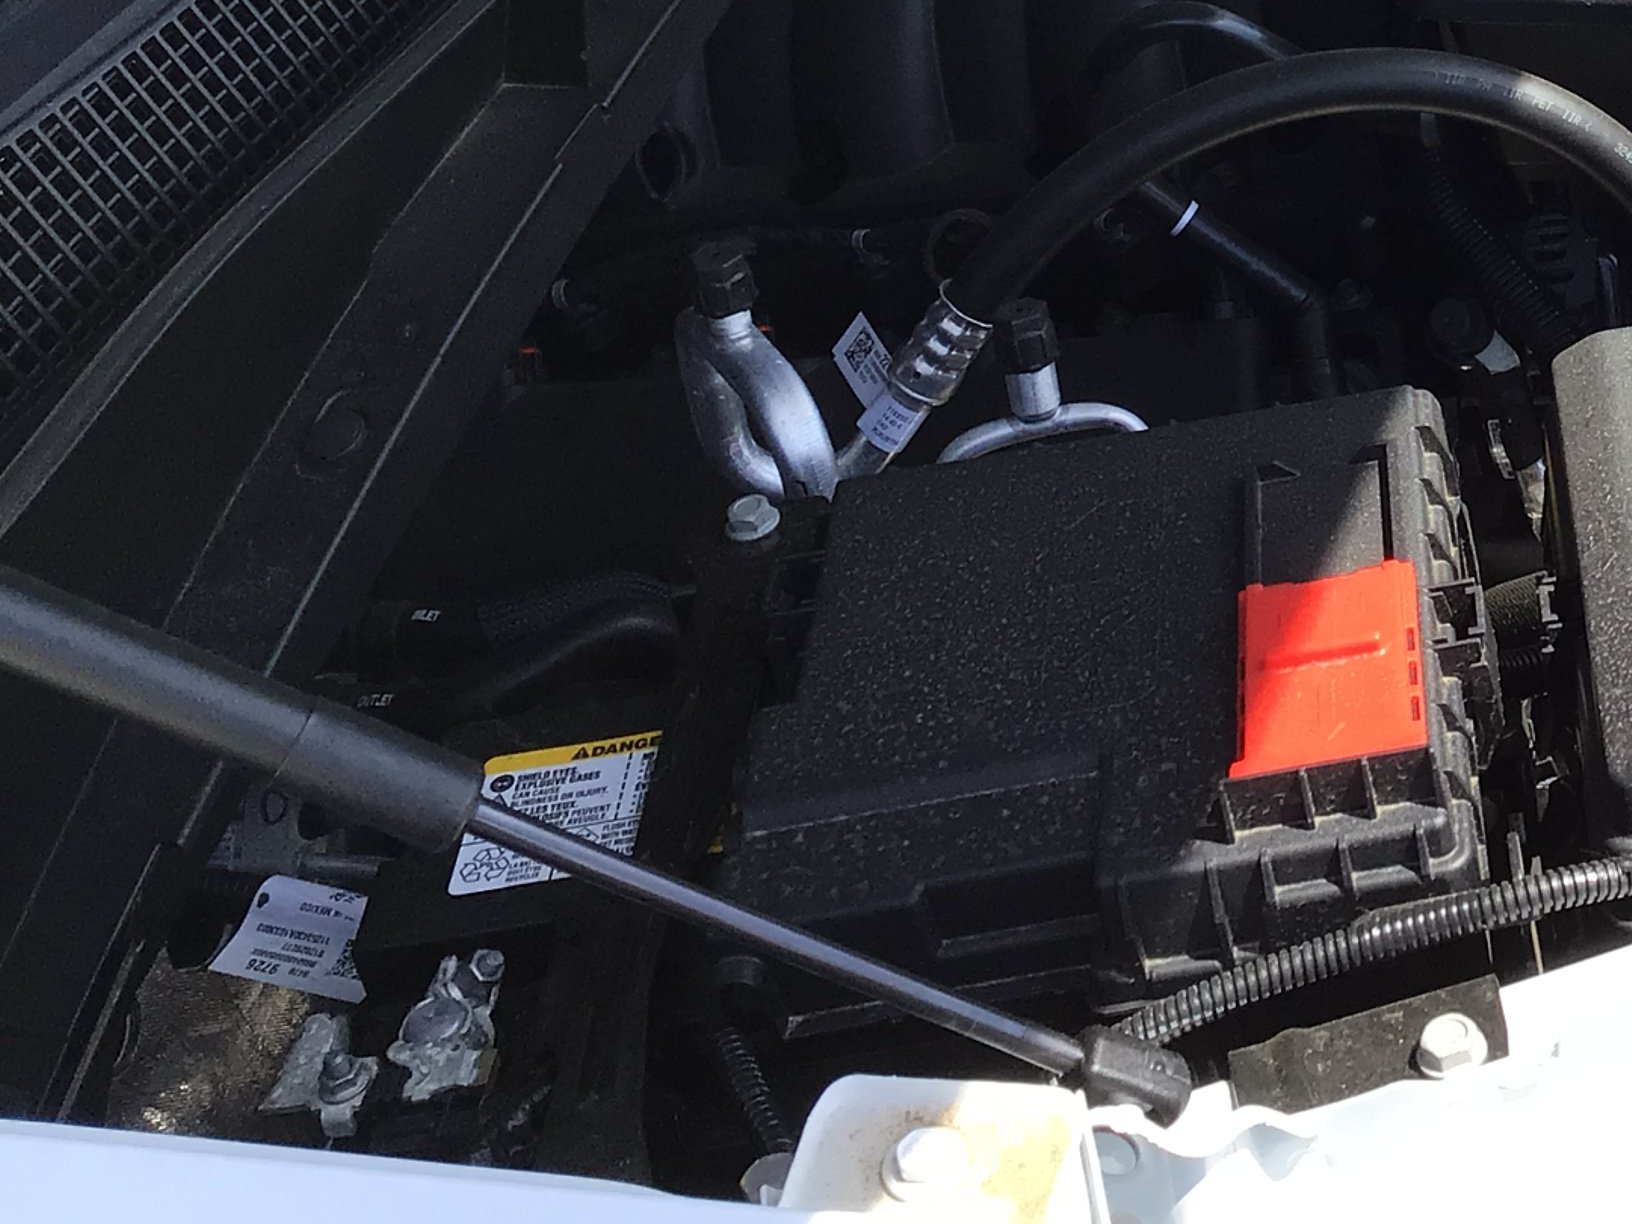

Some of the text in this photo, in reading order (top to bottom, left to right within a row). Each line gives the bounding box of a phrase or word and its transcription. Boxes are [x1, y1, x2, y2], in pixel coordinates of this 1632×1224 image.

[1531, 95, 1553, 112] PET
[357, 693, 394, 707] OUTLET
[592, 736, 661, 757] DANGE
[514, 771, 601, 791] EXPLOSIVE GASES
[517, 770, 552, 782] SHIELD
[511, 794, 558, 807] BLINDNESS
[512, 786, 560, 800] CAN CAUSE
[245, 958, 281, 975] 9726
